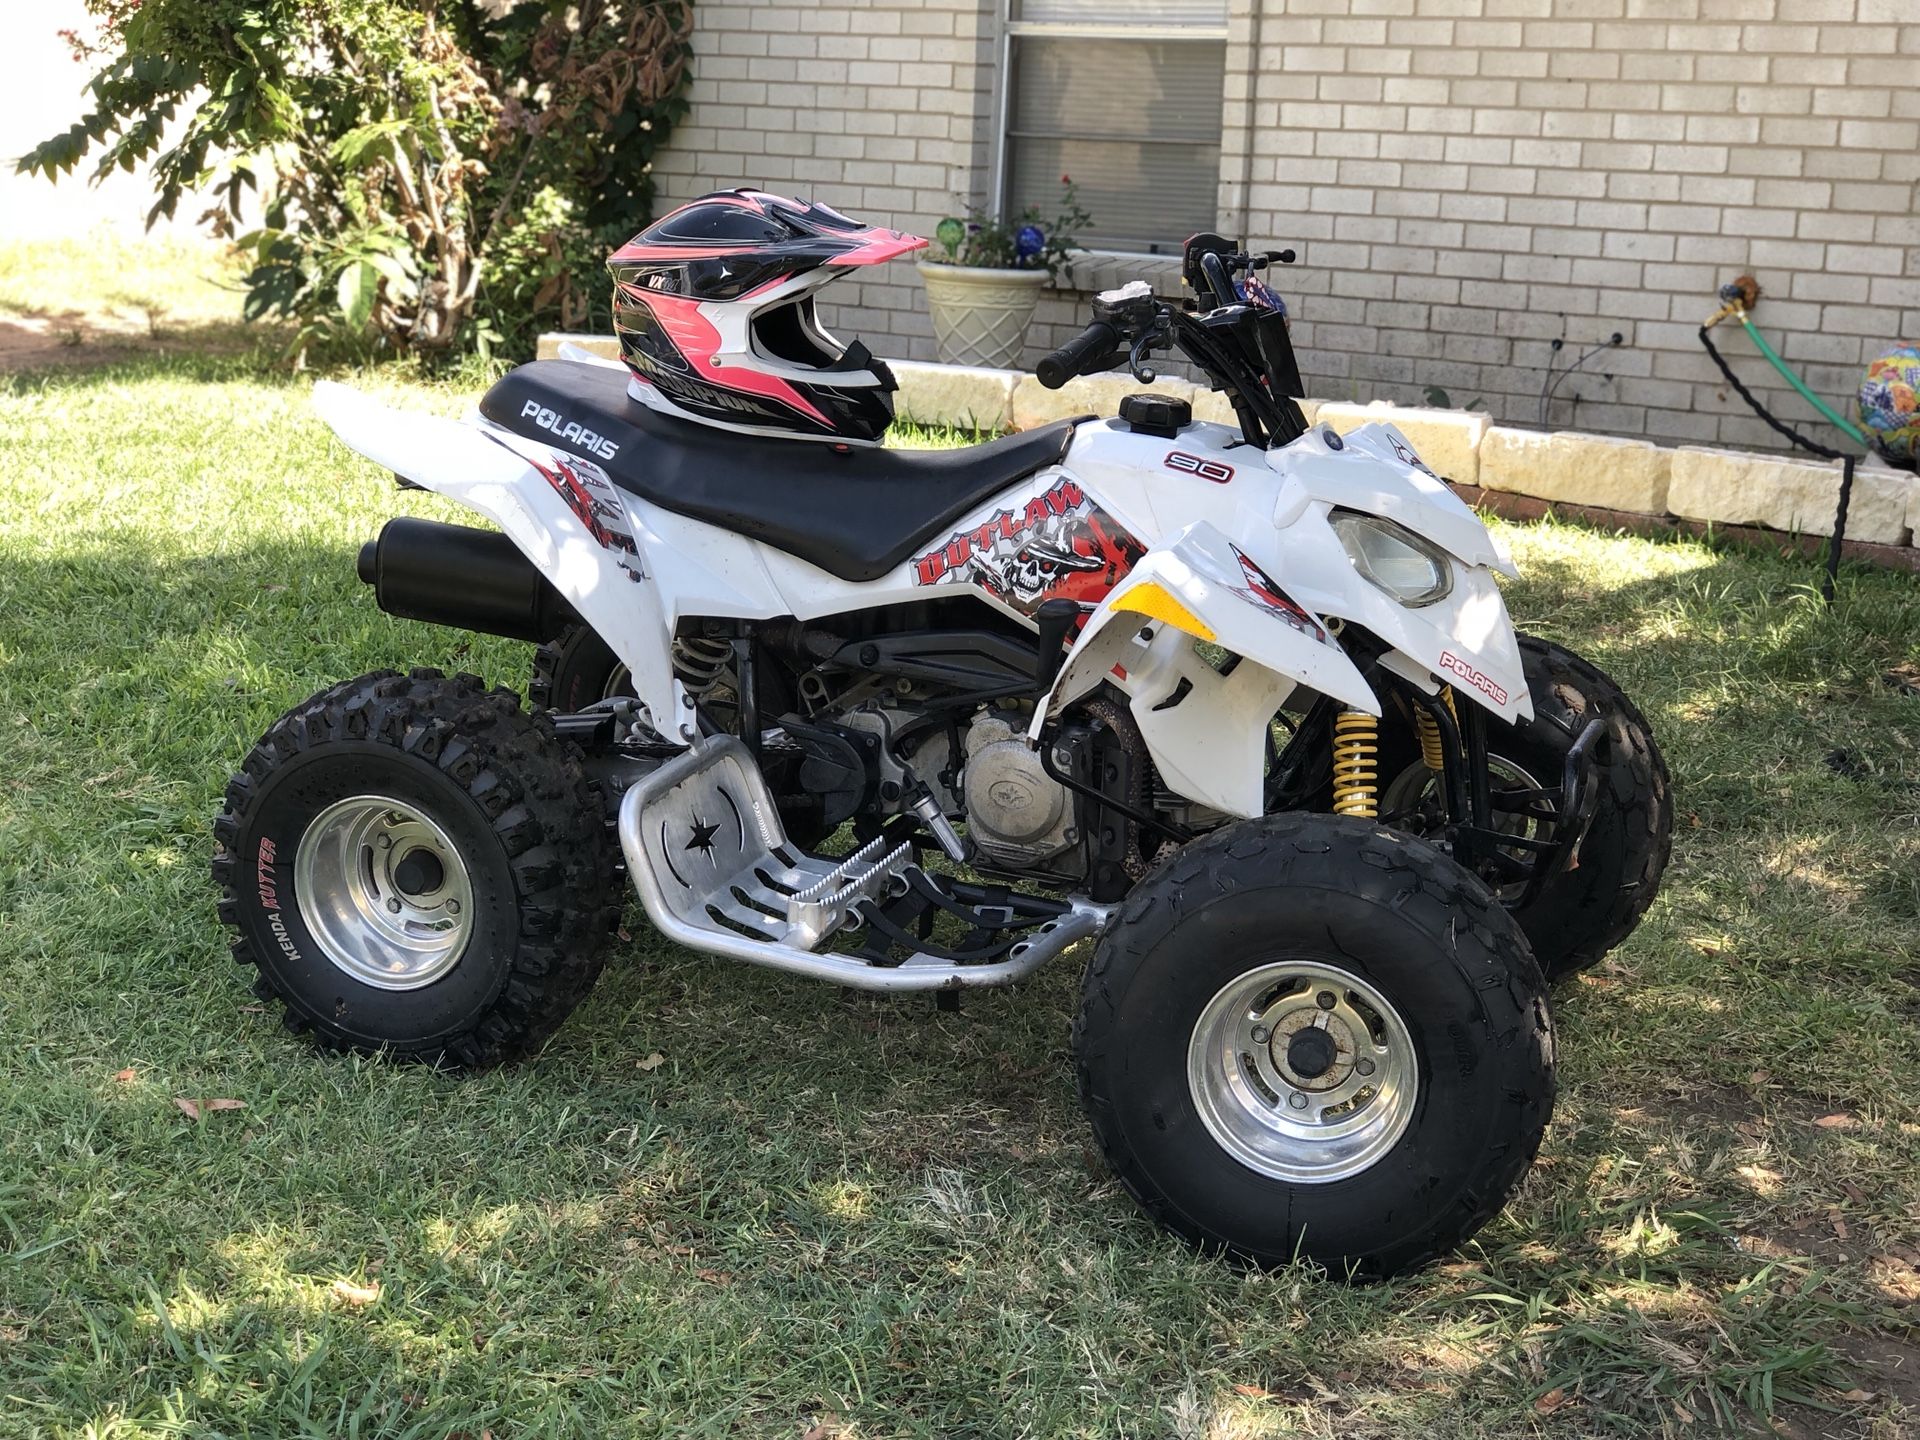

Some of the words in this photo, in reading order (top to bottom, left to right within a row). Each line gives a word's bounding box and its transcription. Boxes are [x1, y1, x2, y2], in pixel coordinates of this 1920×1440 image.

[520, 399, 619, 460] POLARIS
[1165, 451, 1234, 484] 90
[915, 480, 1085, 586] OUTLAW
[1440, 651, 1508, 705] POLARIS
[258, 837, 282, 909] KUTTER
[268, 913, 301, 961] KENDA
